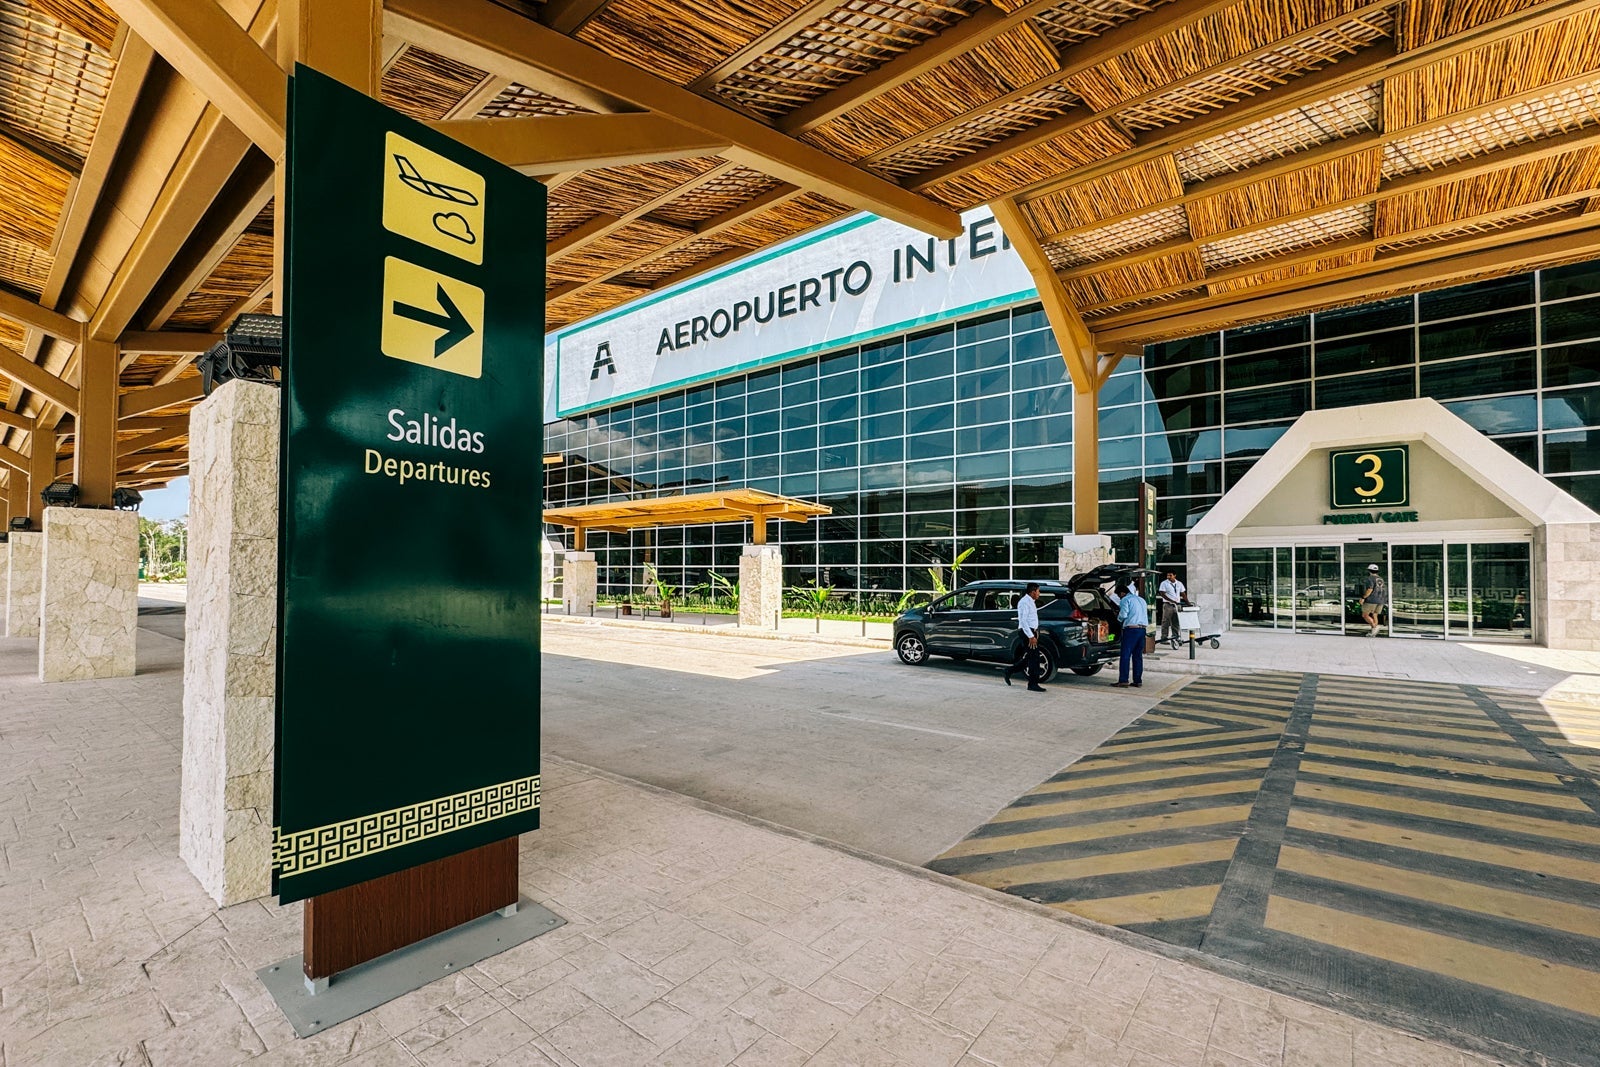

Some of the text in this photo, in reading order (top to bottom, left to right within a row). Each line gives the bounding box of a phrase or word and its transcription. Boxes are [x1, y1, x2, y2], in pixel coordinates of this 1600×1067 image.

[656, 215, 1011, 355] AEROPUERTO INTE
[387, 408, 485, 454] Salidas
[365, 449, 491, 488] Departures
[1354, 453, 1384, 497] 3
